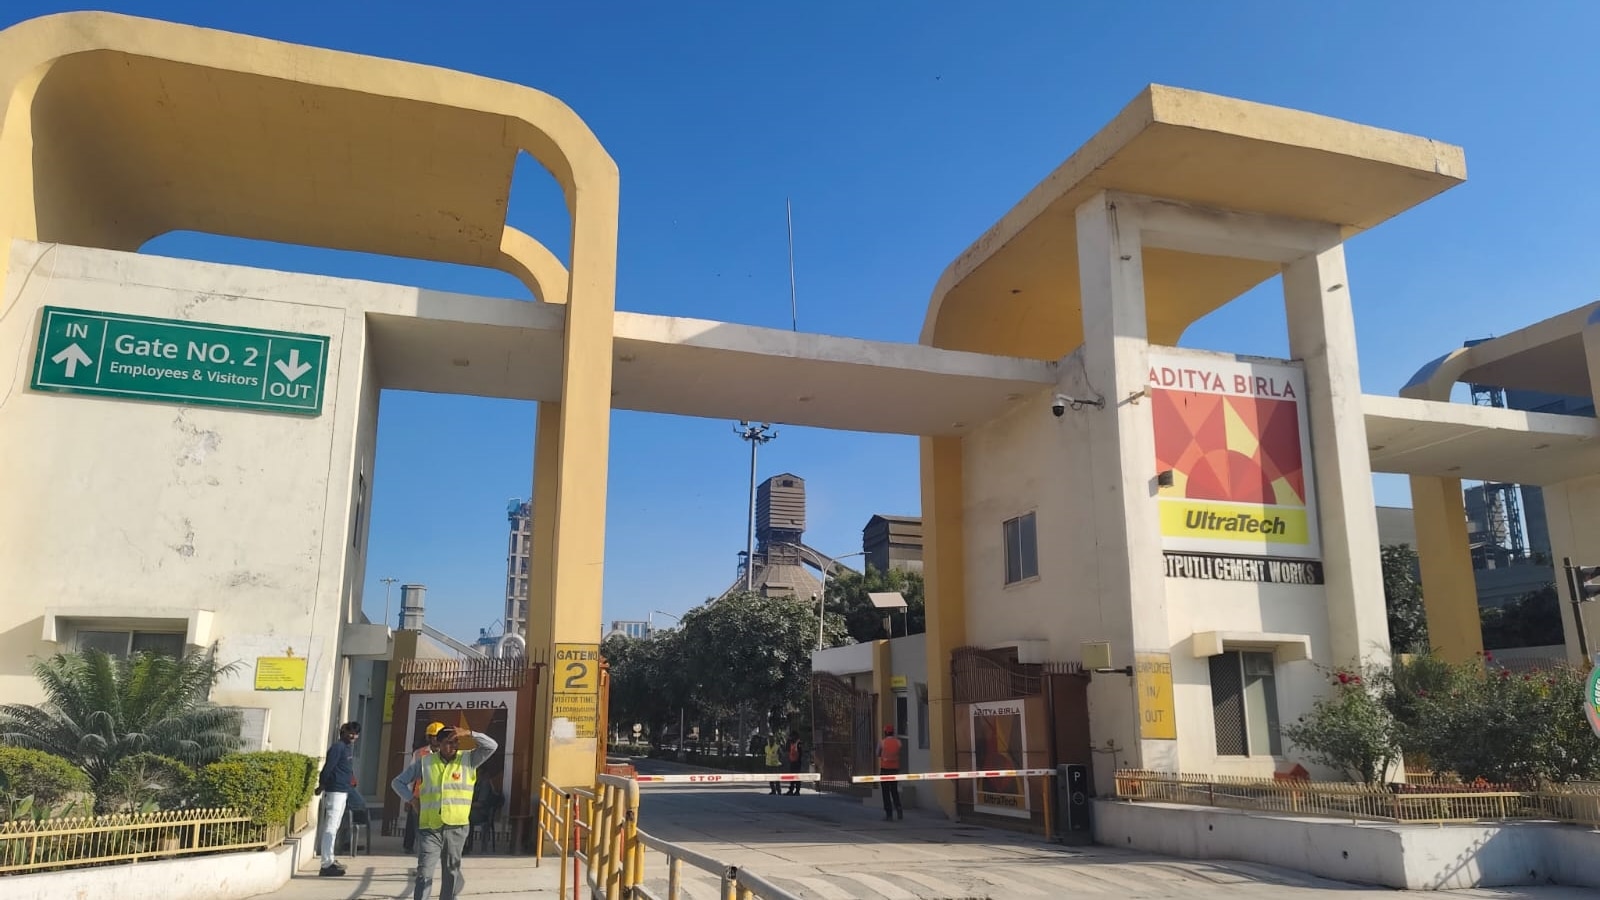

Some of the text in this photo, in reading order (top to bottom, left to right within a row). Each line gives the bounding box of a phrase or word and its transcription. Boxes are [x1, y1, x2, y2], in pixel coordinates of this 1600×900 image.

[65, 323, 88, 339] IN
[114, 334, 258, 367] Gate NO. 2
[110, 362, 258, 386] Employees & Visitors
[1149, 366, 1296, 398] ADITYA BIRLA
[269, 382, 312, 400] OUT
[1186, 510, 1285, 535] UltraTech
[1214, 557, 1265, 581] CEMENT
[1269, 561, 1315, 584] WORKS
[557, 650, 587, 660] GATE
[565, 662, 588, 688] 2
[416, 700, 508, 710] ADITYA BIRLA
[1145, 709, 1164, 723] OUT
